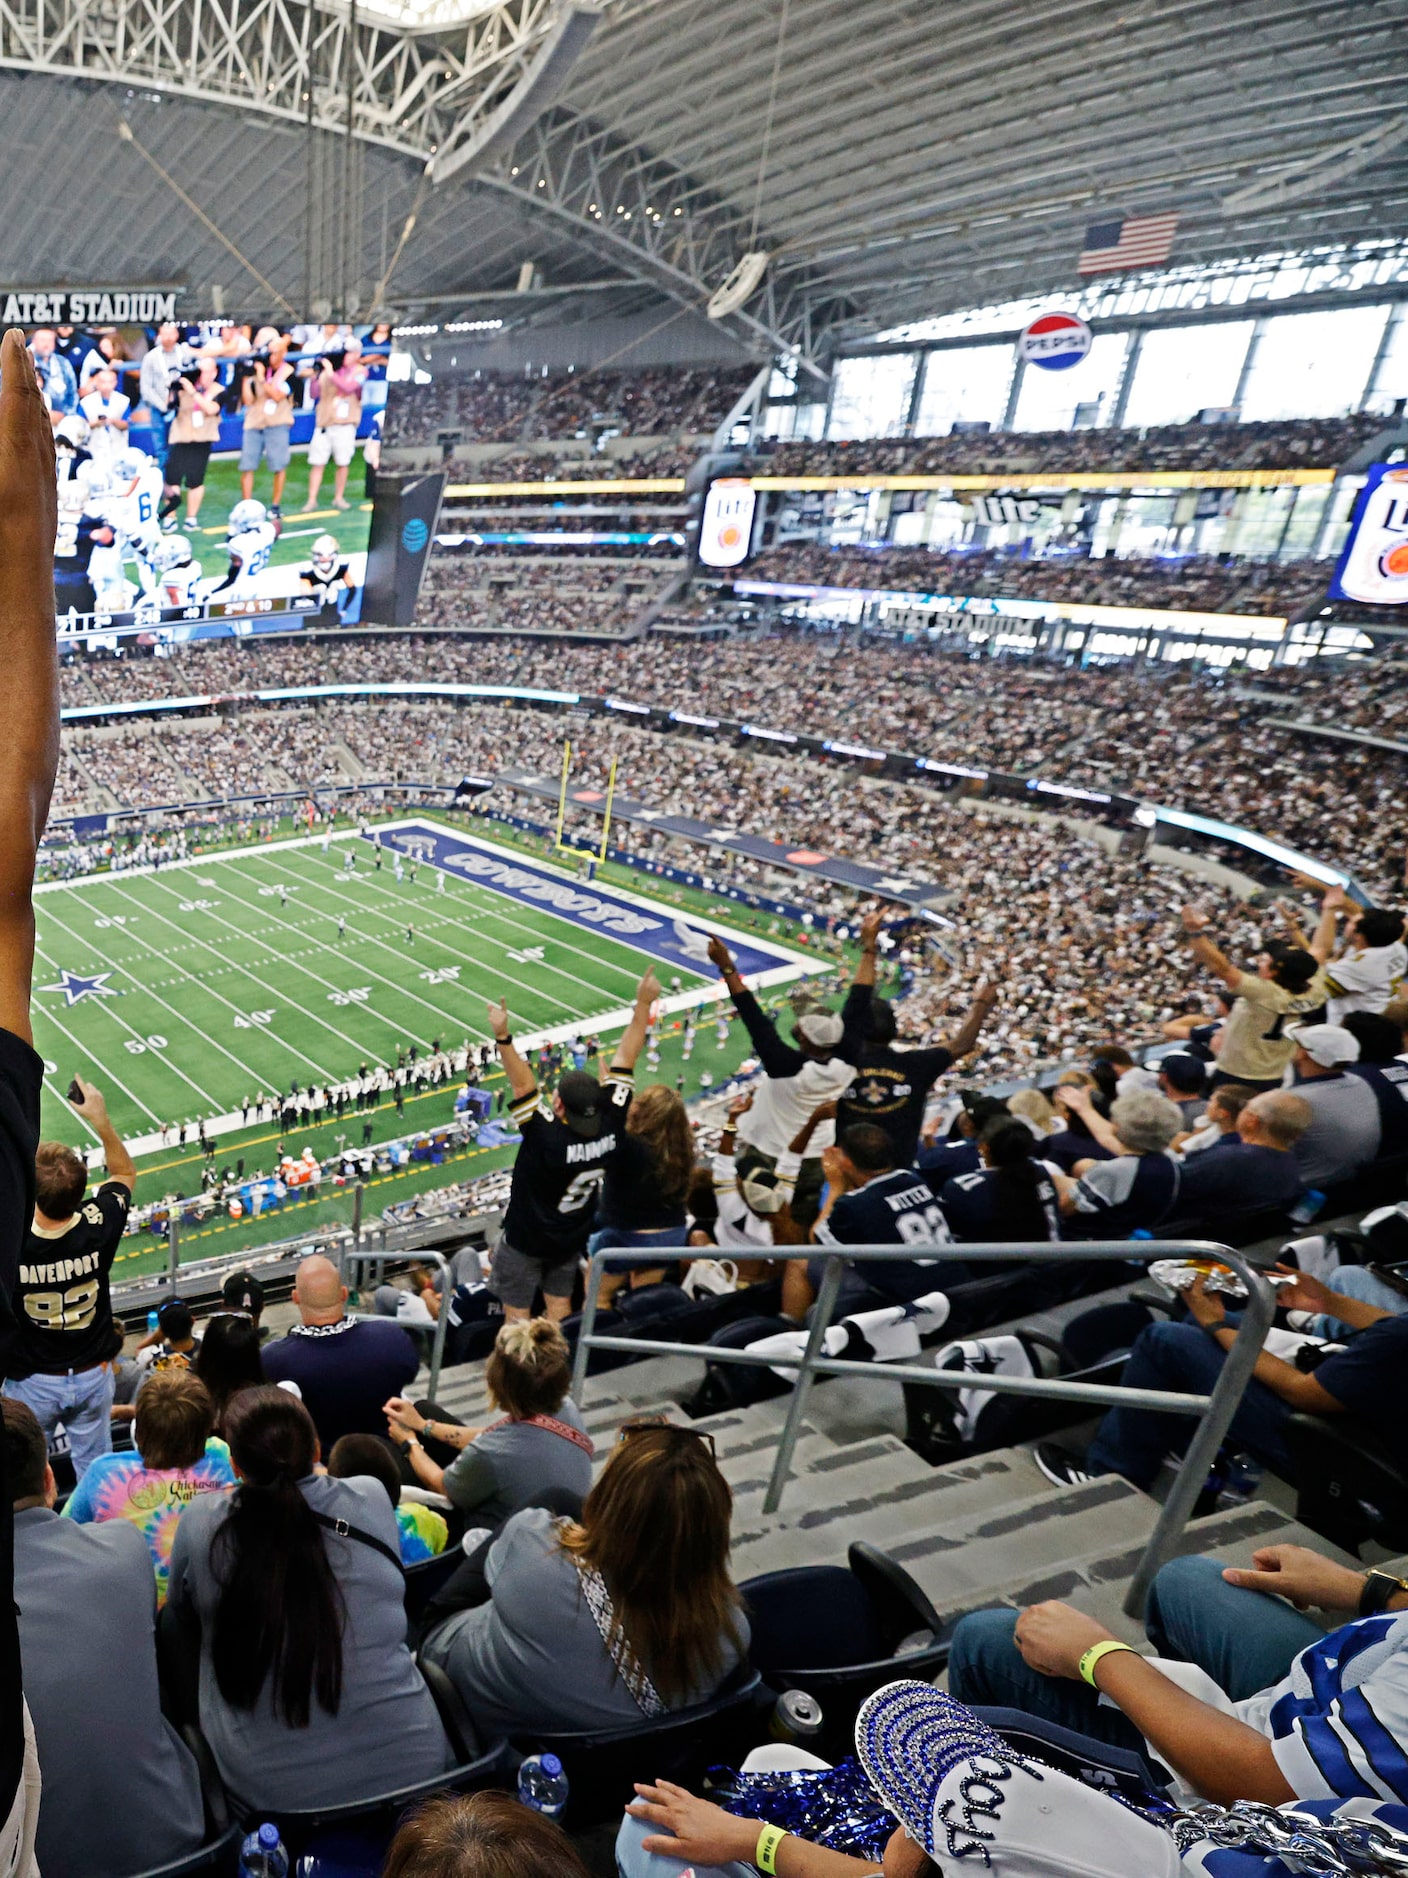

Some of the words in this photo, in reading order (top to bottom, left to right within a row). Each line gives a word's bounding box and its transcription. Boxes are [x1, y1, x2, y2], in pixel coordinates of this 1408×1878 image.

[3, 293, 66, 323] AT&T
[69, 293, 177, 323] STADIUM
[1025, 333, 1086, 352] PEPSI
[883, 608, 932, 630] AT&T
[935, 612, 1036, 637] STADIUM
[444, 852, 664, 934] COWBOYS
[506, 946, 544, 964] 10
[419, 966, 460, 985] 20
[326, 987, 370, 1006] 30
[233, 1009, 273, 1030] 40
[123, 1034, 169, 1056] 50
[18, 1251, 100, 1284] DAVENPORT
[22, 1278, 100, 1331] 92
